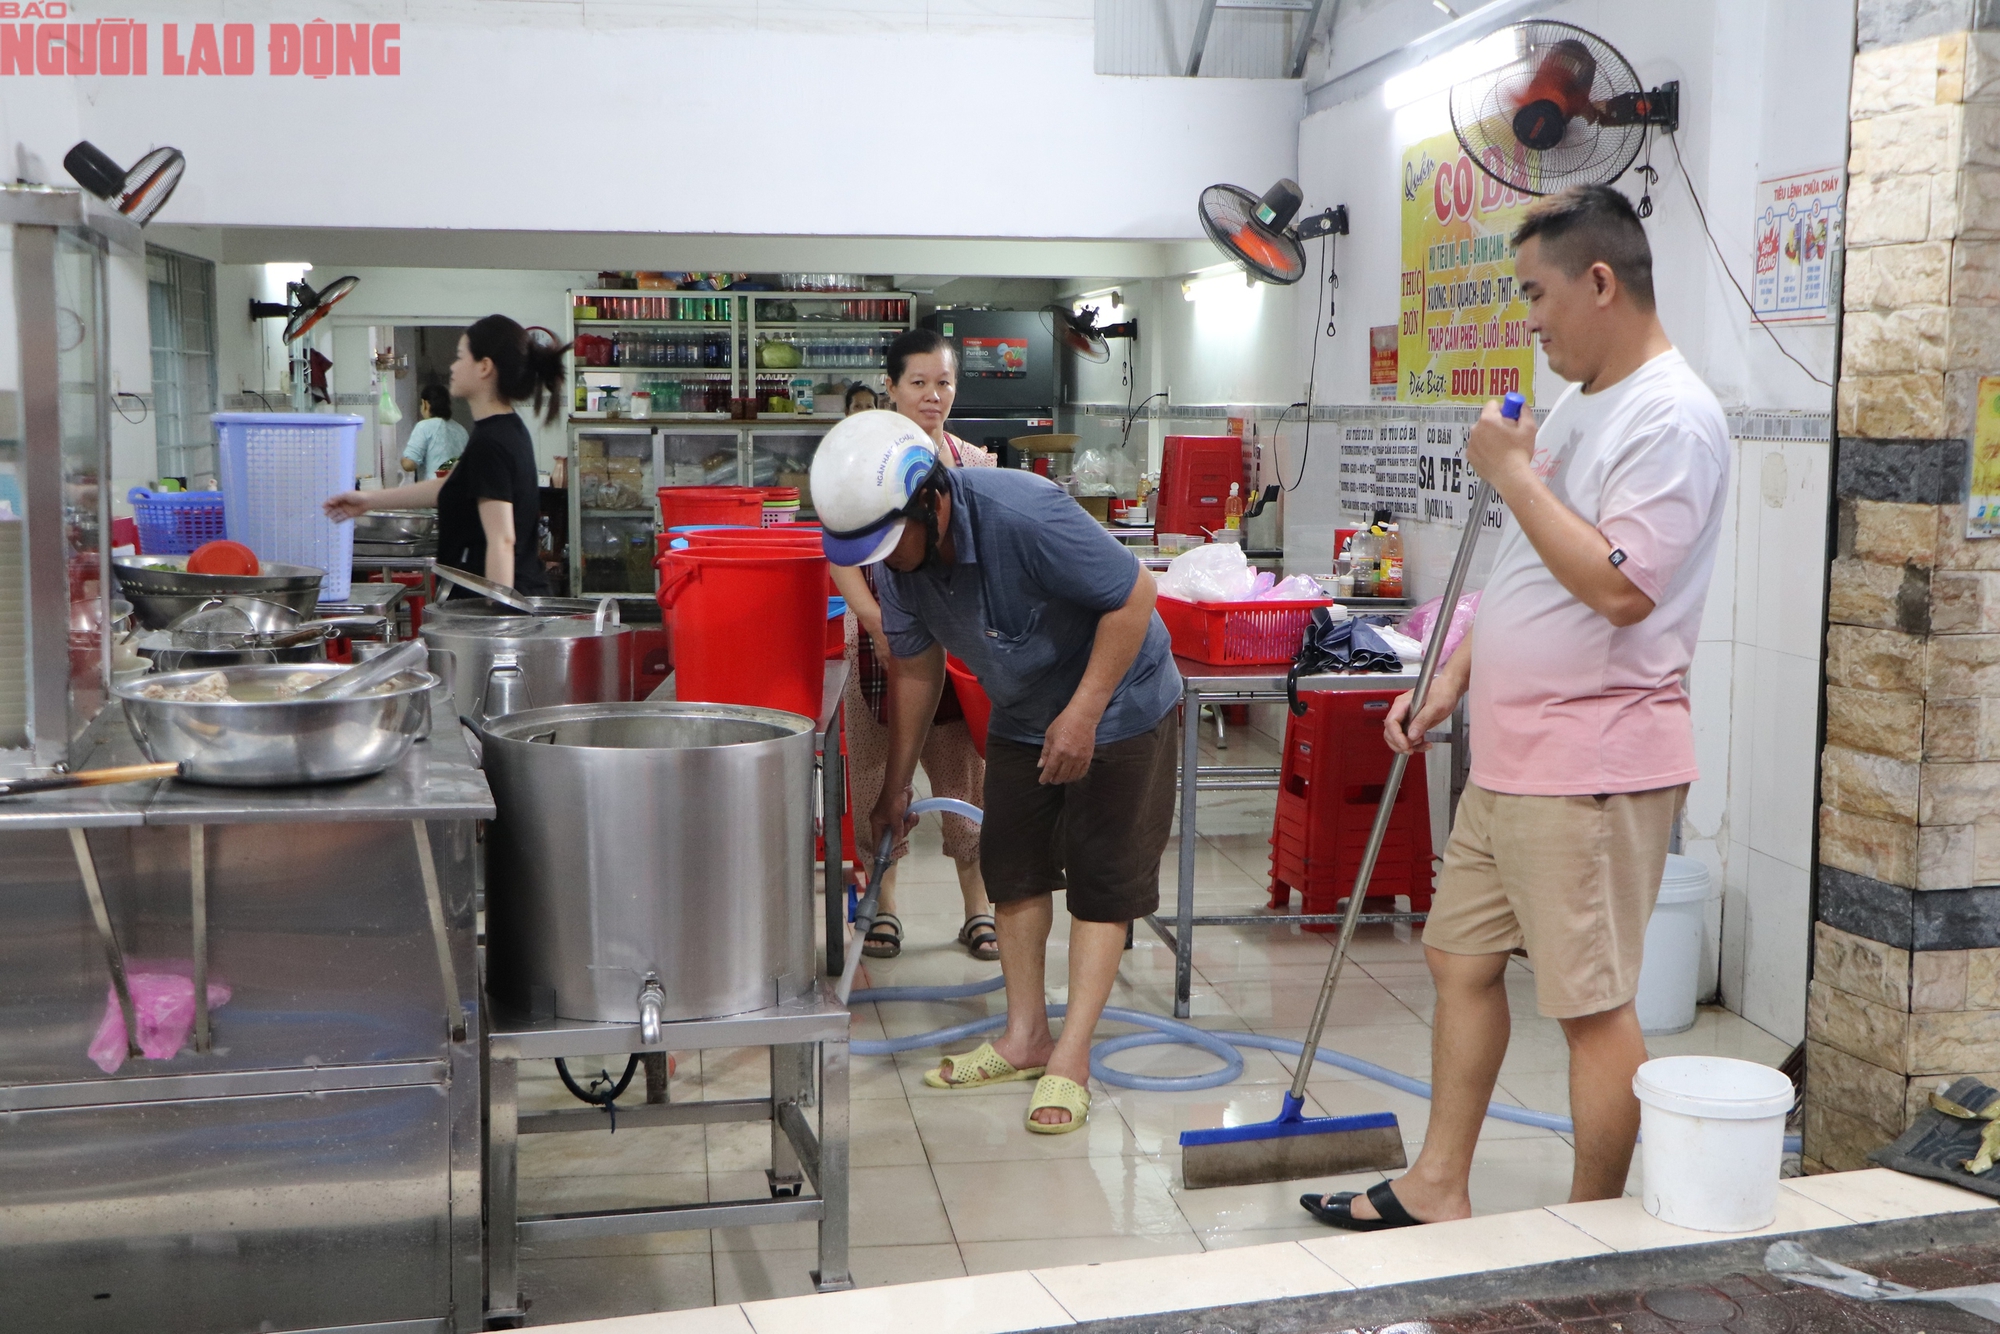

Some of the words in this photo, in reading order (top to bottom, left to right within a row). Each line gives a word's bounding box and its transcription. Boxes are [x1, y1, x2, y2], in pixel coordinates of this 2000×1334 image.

[1774, 184, 1786, 201] TIÊU
[1787, 181, 1802, 201] LỆNH
[1803, 179, 1820, 196] CHỮA
[1821, 175, 1839, 194] CHÁY
[1401, 266, 1422, 301] THỰC
[1497, 277, 1513, 310] THỊT
[1403, 306, 1419, 336] ĐƠN
[1428, 321, 1444, 358] THẬP
[1445, 313, 1459, 351] CẨM
[1505, 320, 1520, 347] BAO
[1409, 370, 1425, 397] Đặc
[1452, 361, 1485, 396] ĐUÔI
[1489, 367, 1520, 397] HEO
[1437, 426, 1452, 445] BÁN
[1418, 454, 1436, 491] SA
[1440, 446, 1462, 494] TẾ
